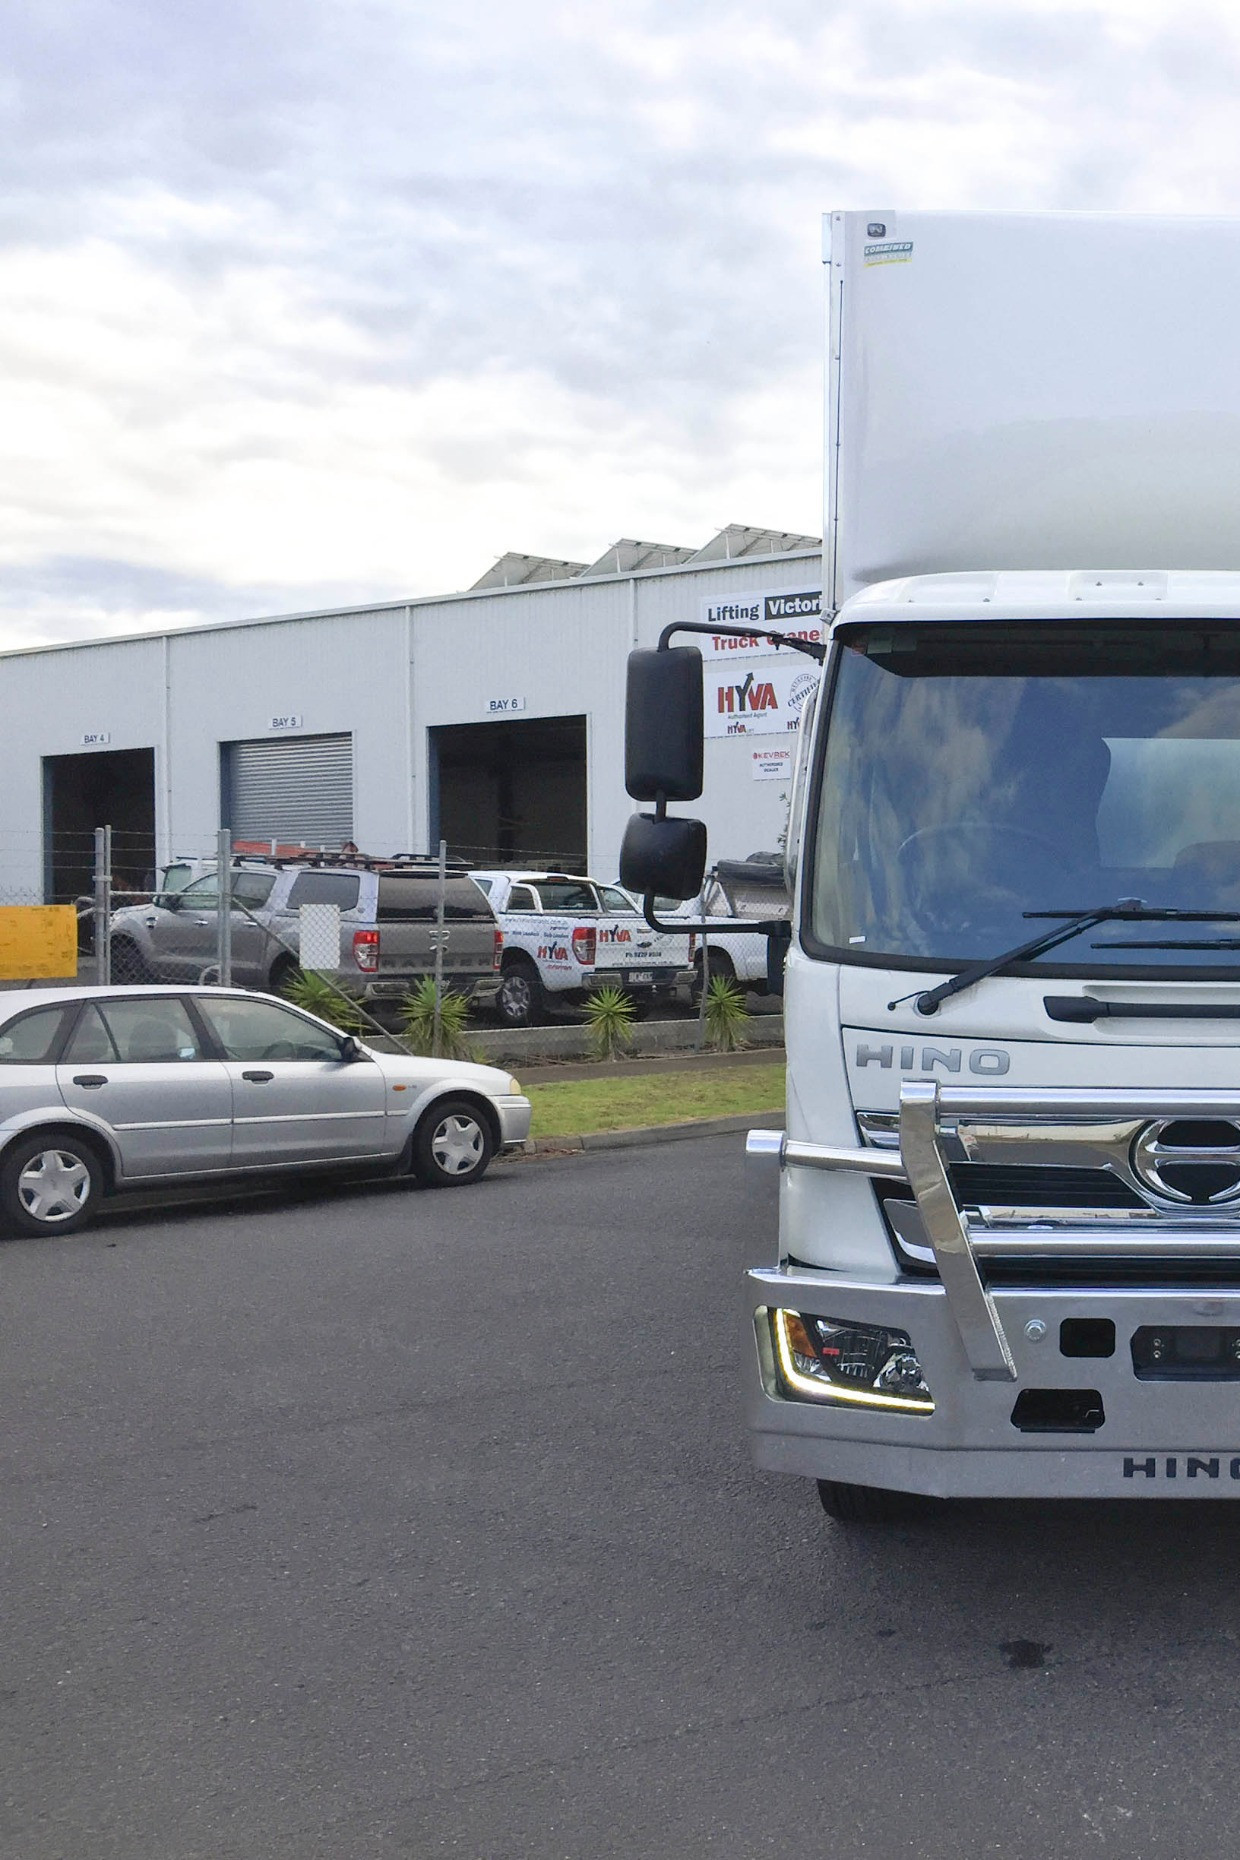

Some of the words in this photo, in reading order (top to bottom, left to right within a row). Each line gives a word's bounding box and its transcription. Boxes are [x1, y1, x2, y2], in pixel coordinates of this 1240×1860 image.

[708, 604, 760, 622] Lifting
[712, 634, 759, 651] Truck
[717, 673, 778, 713] HYVA
[490, 700, 509, 710] BAY
[511, 699, 517, 708] 6
[272, 718, 289, 727] BAY
[290, 717, 296, 726] 5
[727, 722, 746, 734] HYVA
[84, 735, 98, 743] BAY
[100, 734, 105, 742] 4
[600, 924, 632, 942] HYVA
[537, 941, 568, 960] HYVA
[856, 1044, 1011, 1076] HINO
